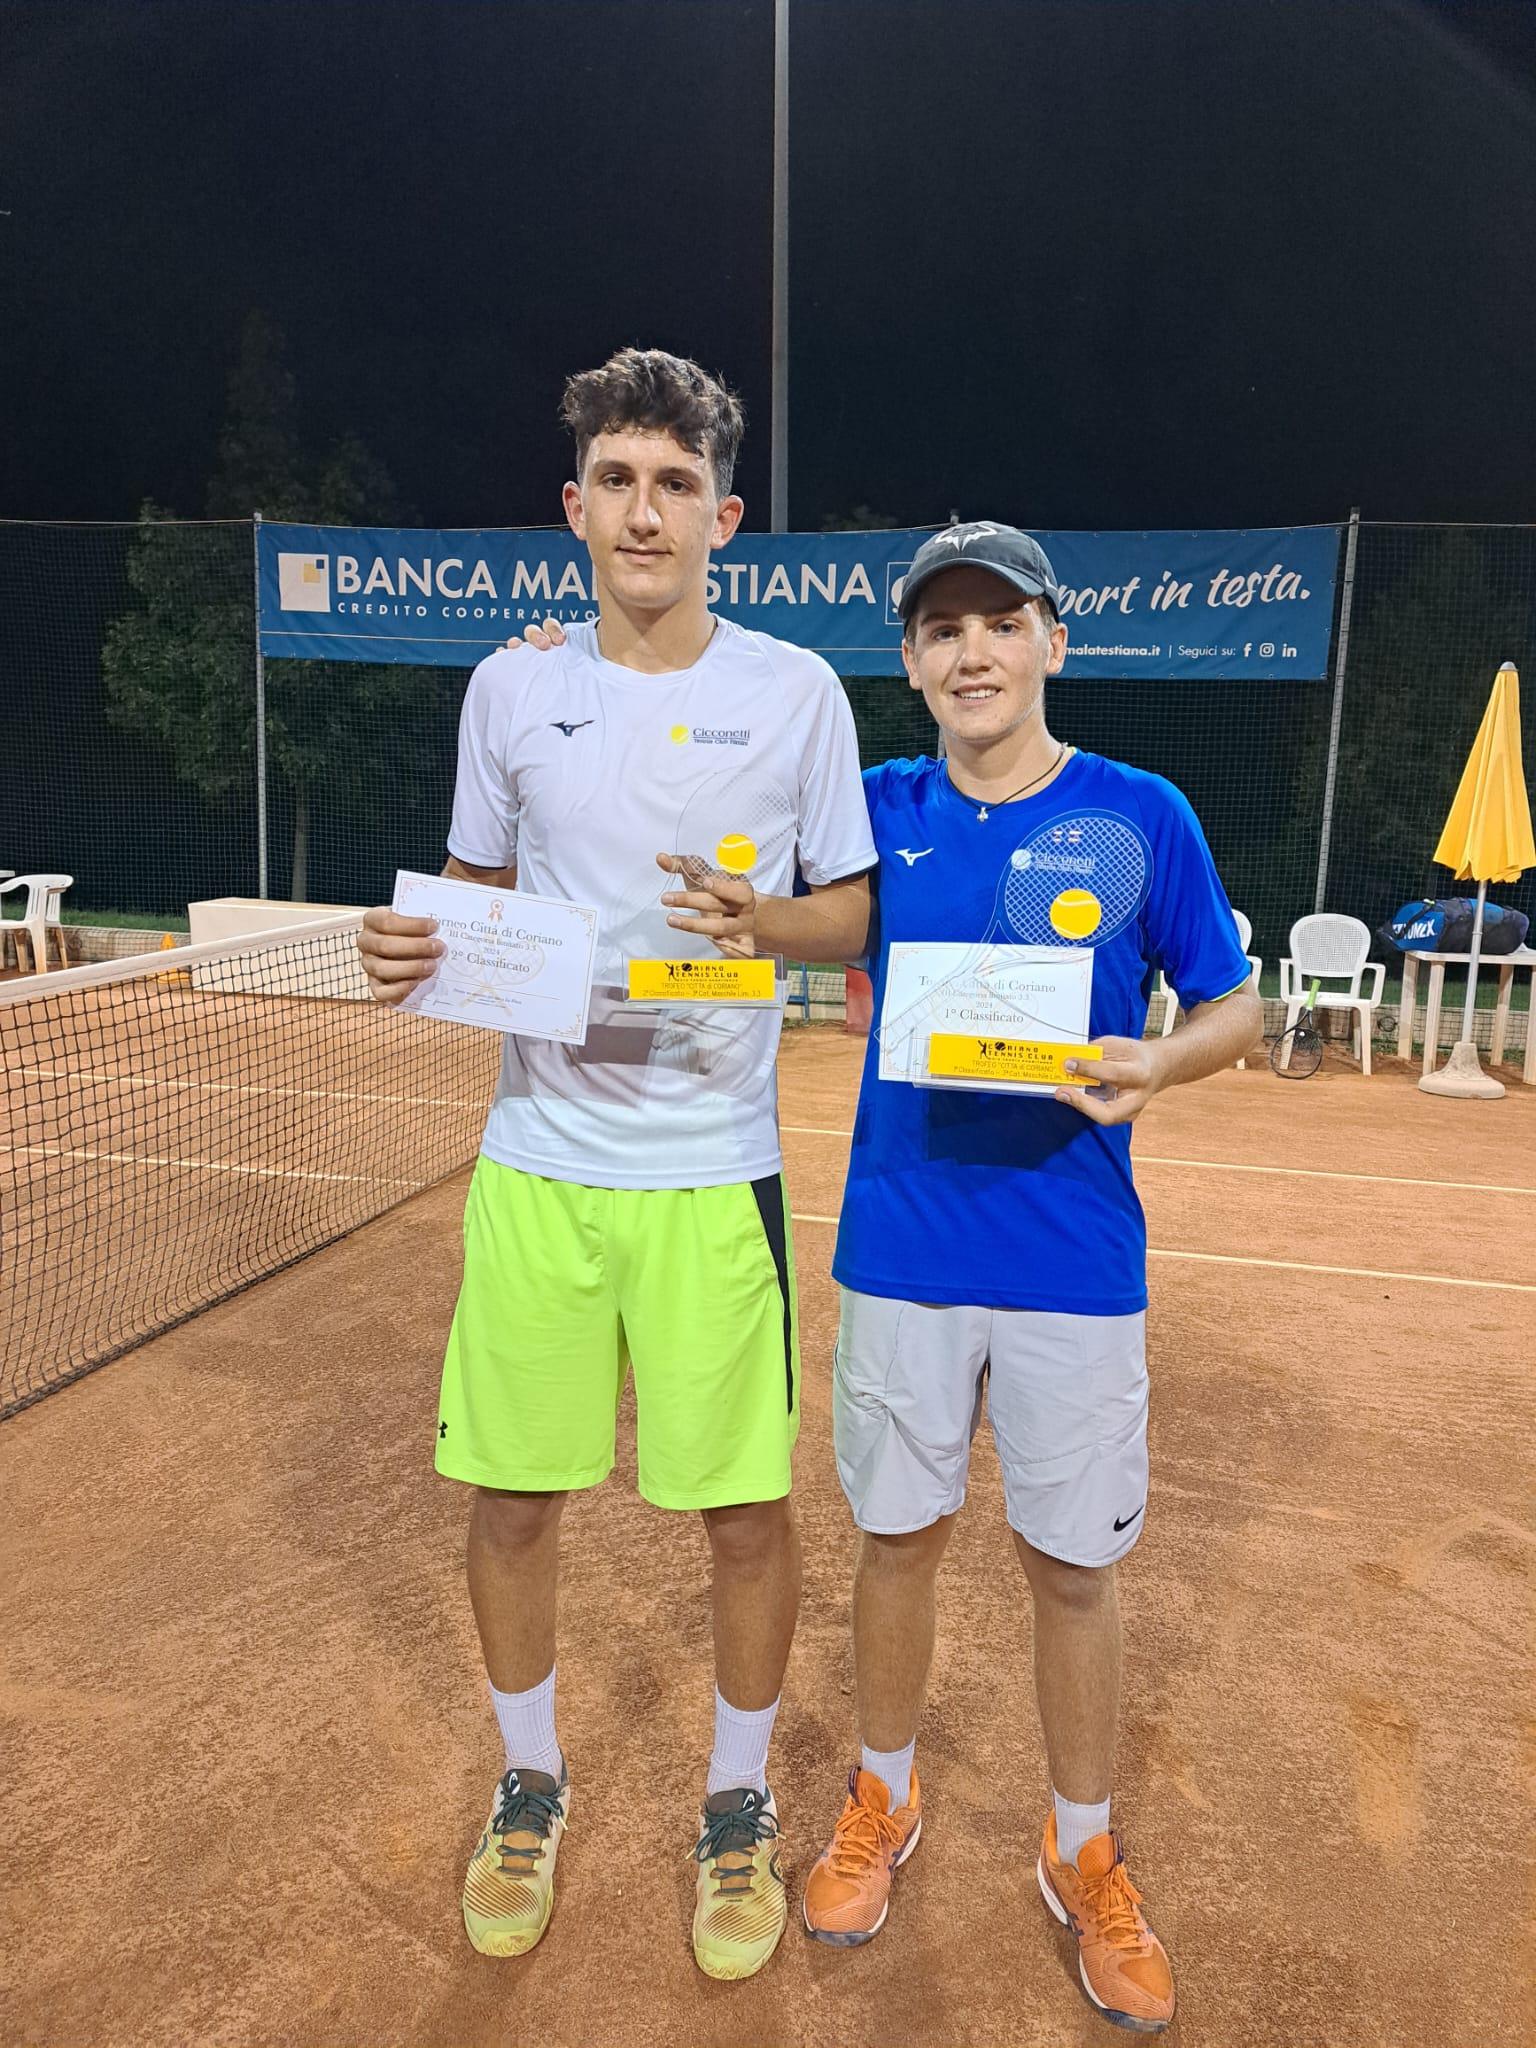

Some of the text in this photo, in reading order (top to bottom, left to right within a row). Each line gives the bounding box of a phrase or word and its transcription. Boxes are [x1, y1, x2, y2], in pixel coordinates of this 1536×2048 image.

[337, 555, 877, 605] BANCA MASTIANA
[1057, 563, 1311, 616] port in testa.
[338, 602, 597, 621] CREDITO COOPERATIVO
[1066, 643, 1161, 656] malatestiana.it
[1177, 644, 1217, 659] Seguici
[1221, 645, 1236, 656] su:
[501, 926, 512, 938] di
[516, 928, 563, 947] Coriano
[1404, 919, 1435, 940] ONEX
[466, 952, 530, 973] Classificato
[1008, 980, 1056, 993] Coriano
[959, 1008, 1024, 1023] Classificato
[988, 1050, 1023, 1058] TENNIS
